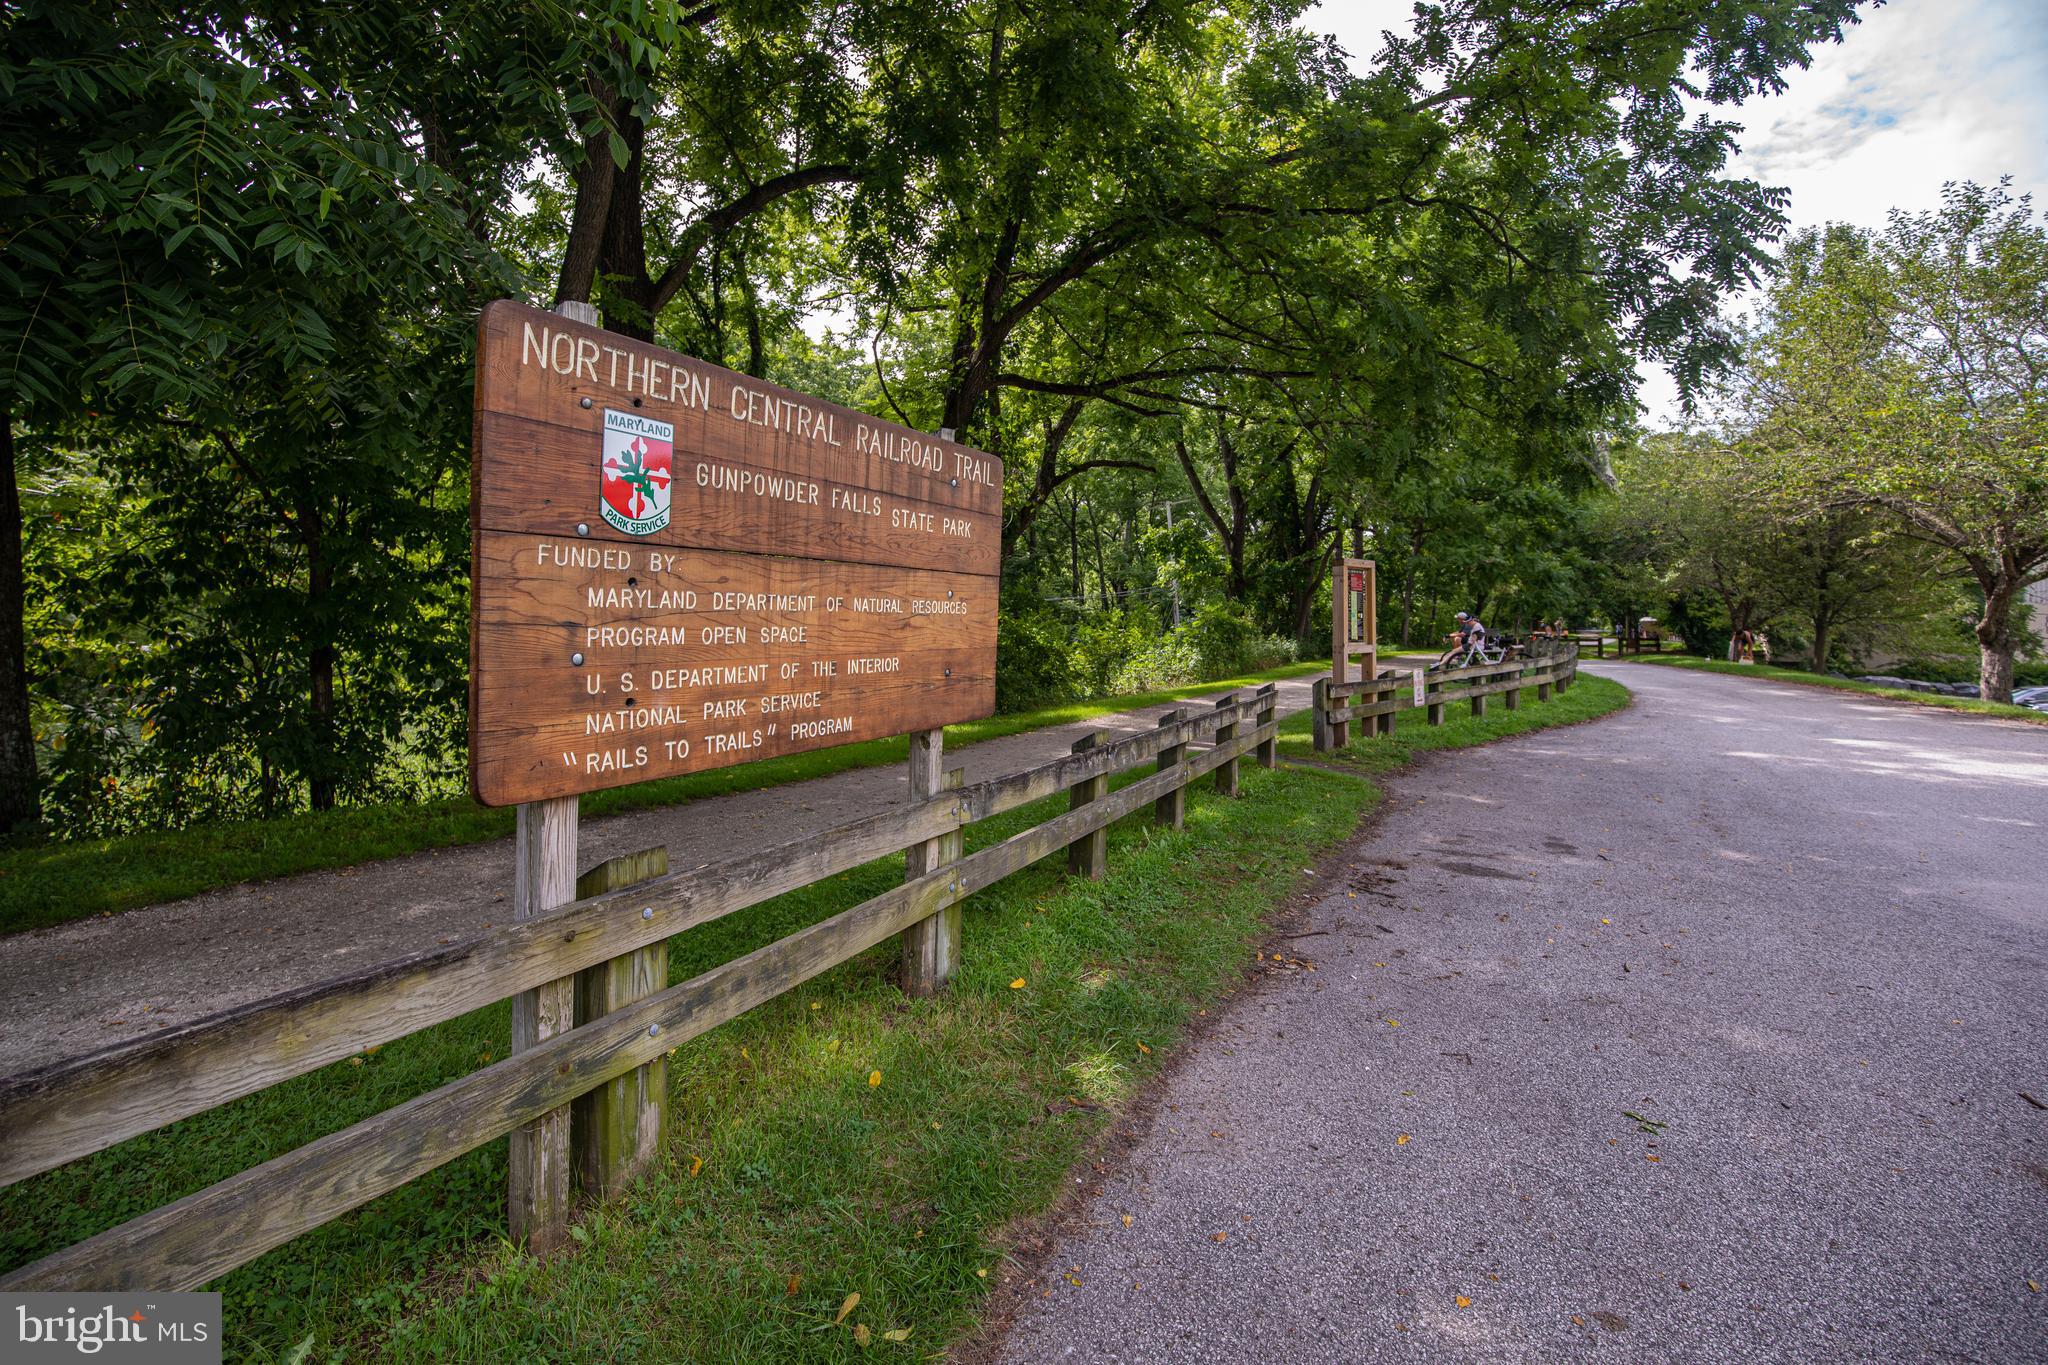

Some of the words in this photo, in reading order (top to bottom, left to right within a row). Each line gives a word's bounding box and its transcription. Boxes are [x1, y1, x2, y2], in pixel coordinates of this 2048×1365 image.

[522, 321, 711, 412] NORTHERN
[731, 384, 841, 447] CENTRAL
[856, 423, 943, 473] RAILROAD
[953, 452, 995, 488] TRAIL
[607, 413, 671, 438] MARYLAND
[696, 462, 819, 506] GUNPOWDER
[831, 487, 882, 517] FALLS
[891, 508, 935, 534] STATE
[943, 517, 972, 539] PARK
[605, 509, 629, 531] PARK
[630, 515, 667, 533] SERVICE
[537, 544, 631, 570] FUNDED
[649, 551, 683, 573] BY:
[587, 587, 697, 609] MARYLAND
[712, 592, 816, 612] DEPARTMENT
[826, 596, 843, 612] OF
[853, 597, 903, 614] NATURAL
[911, 600, 967, 615] RESOURCES
[587, 627, 685, 648] PROGRAM
[701, 626, 746, 645] OPEN
[760, 626, 807, 644] SPACE
[651, 664, 769, 690] DEPARTMENT
[780, 662, 800, 680] OF
[811, 660, 837, 677] THE
[847, 657, 899, 675] INTERIOR
[585, 705, 687, 736] NATIONAL
[703, 698, 747, 720] PARK
[760, 691, 821, 714] SERVICE
[665, 738, 689, 760] TO
[791, 716, 853, 741] PROGRAM
